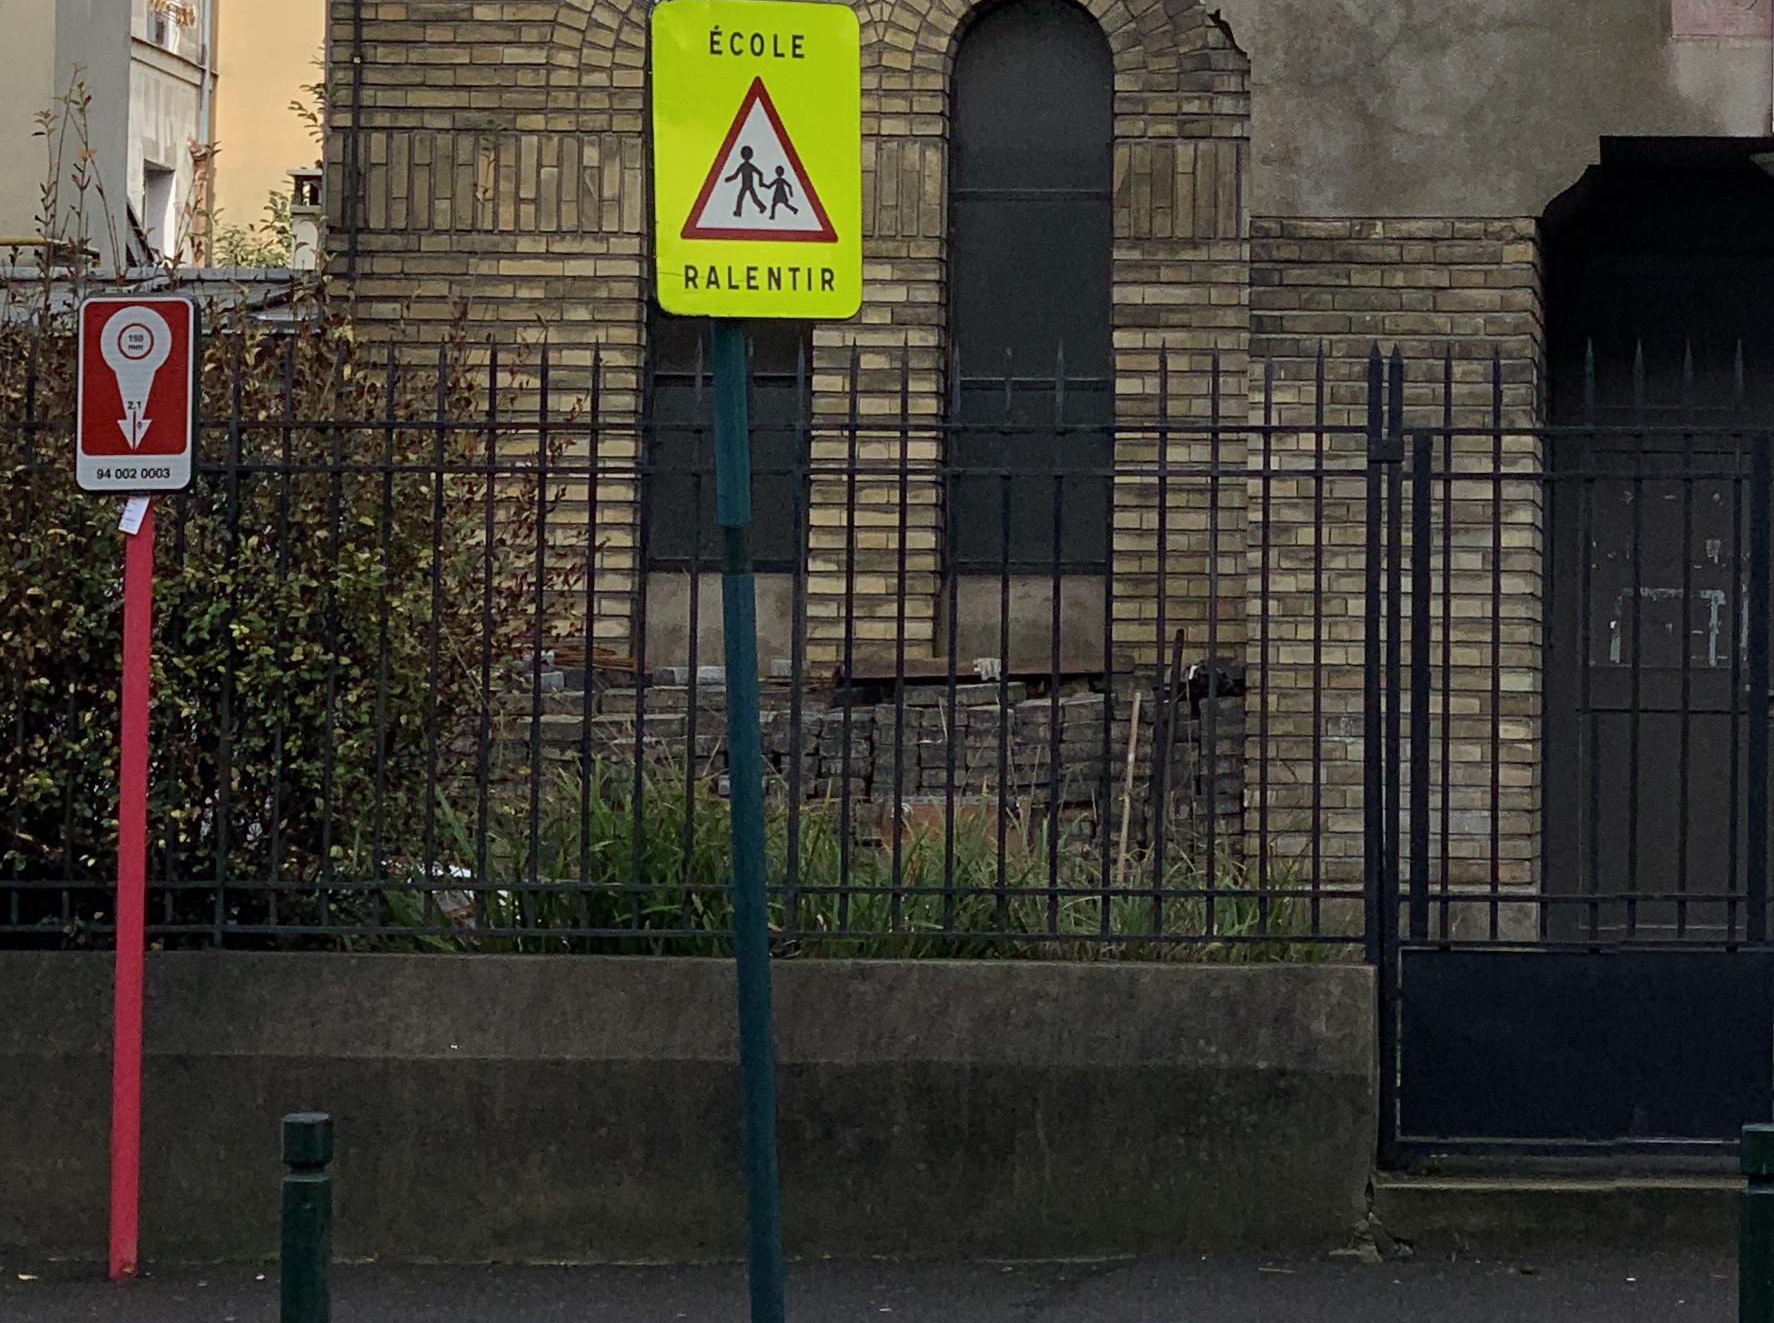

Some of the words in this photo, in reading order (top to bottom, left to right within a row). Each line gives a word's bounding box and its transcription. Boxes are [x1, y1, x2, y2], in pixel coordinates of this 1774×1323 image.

[709, 24, 805, 59] ÉCOLE
[684, 264, 835, 292] RALENTIR
[97, 468, 111, 480] 94
[115, 468, 137, 479] 002
[141, 467, 170, 479] 0003
